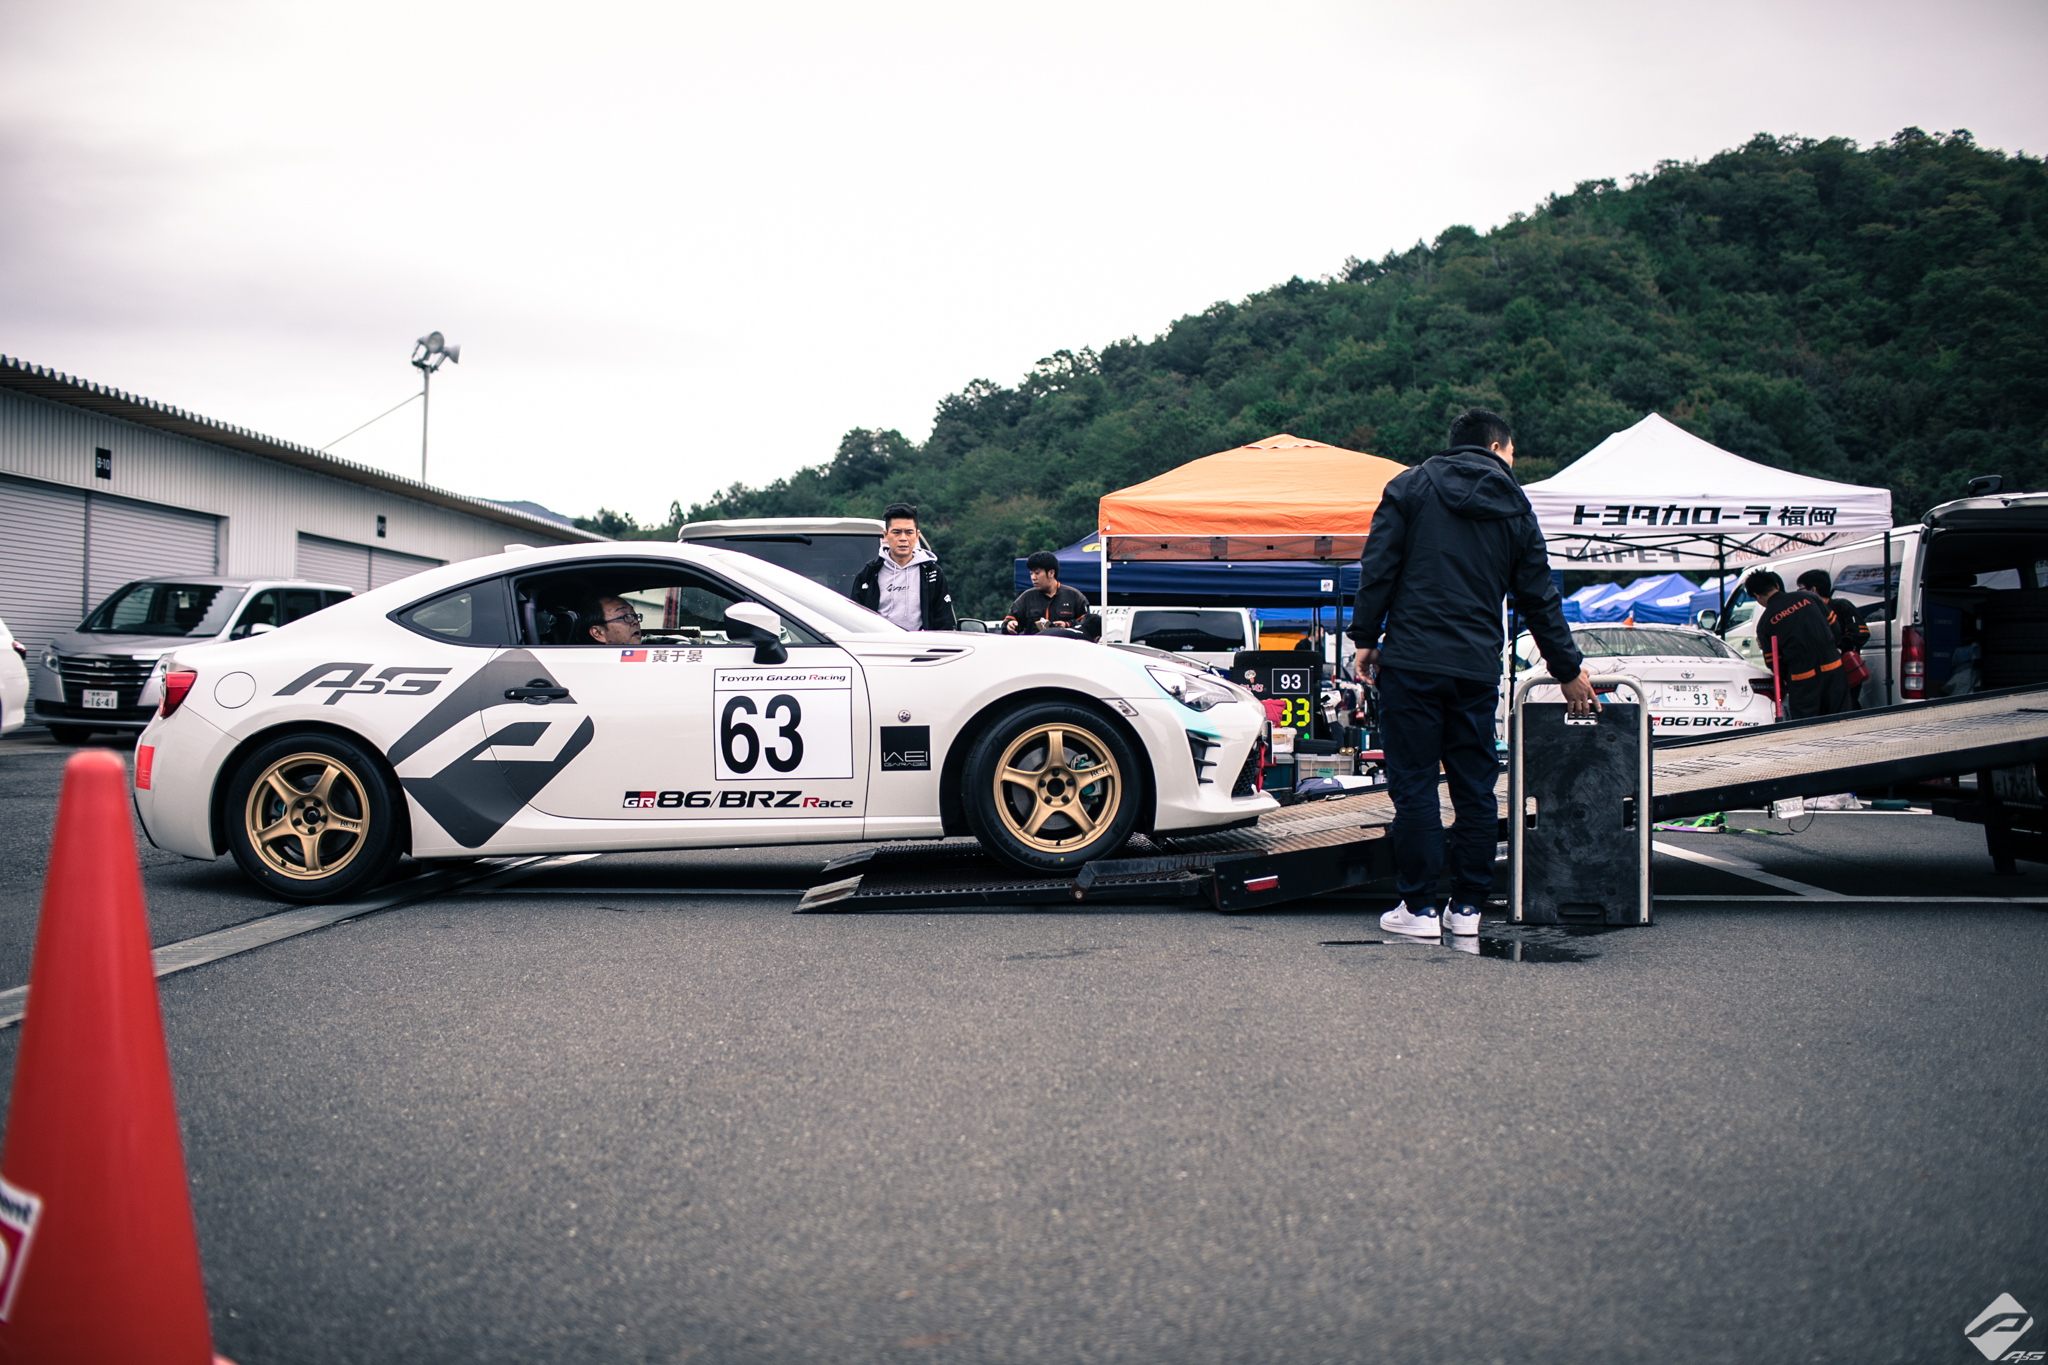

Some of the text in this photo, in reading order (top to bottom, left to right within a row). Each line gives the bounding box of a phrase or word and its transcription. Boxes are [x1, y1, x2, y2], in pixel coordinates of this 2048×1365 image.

[97, 457, 110, 470] B-10
[1770, 599, 1811, 625] COROLLA
[809, 673, 846, 682] Racing
[1280, 674, 1301, 689] 93
[91, 698, 114, 707] 16-41
[1694, 693, 1708, 706] 93
[1661, 717, 1734, 726] 86/BRZ
[721, 694, 804, 774] 63
[883, 751, 928, 762] WEI
[624, 791, 853, 807] GR 86/BRZ Race
